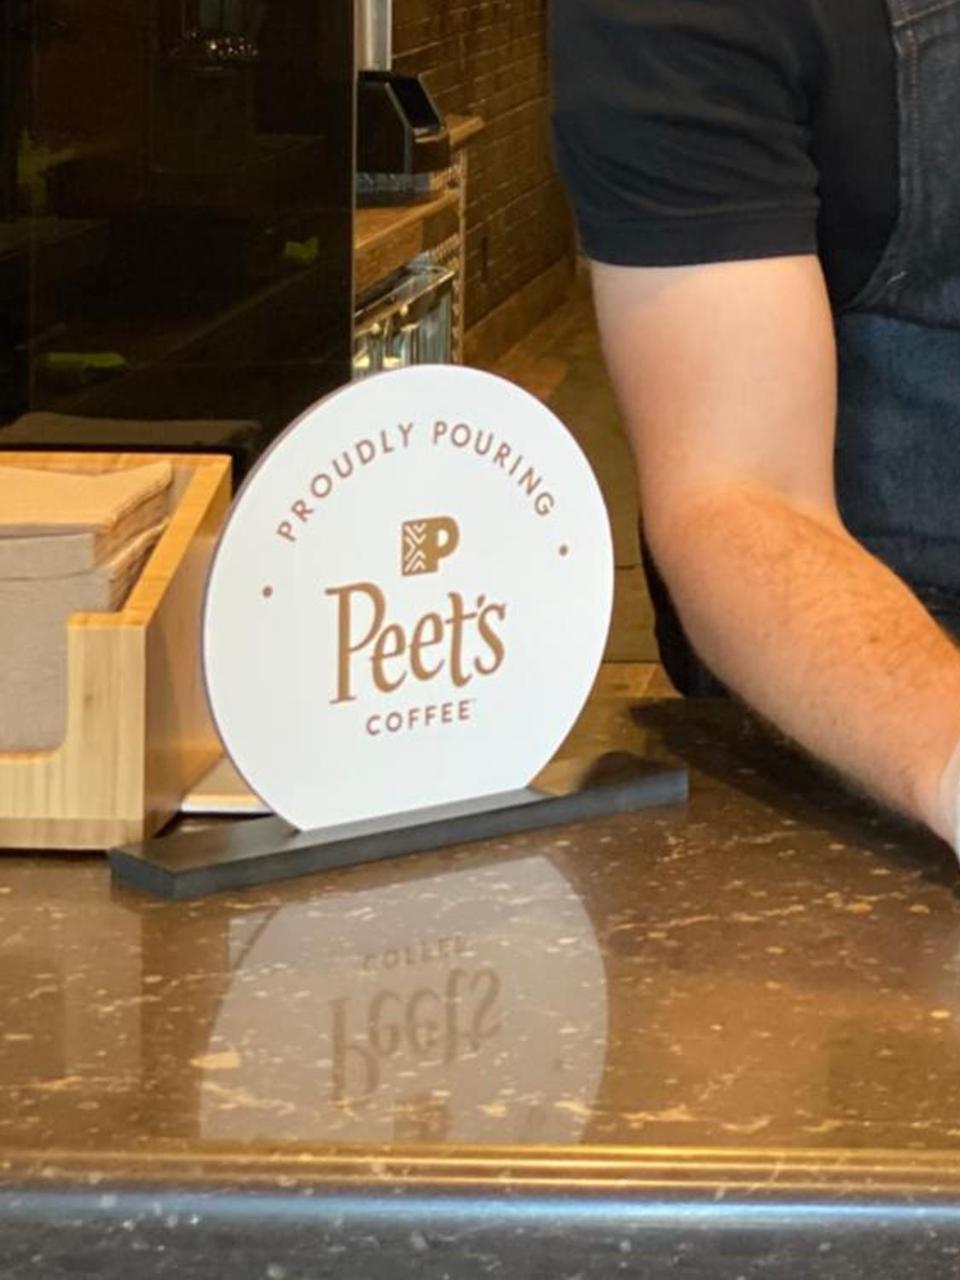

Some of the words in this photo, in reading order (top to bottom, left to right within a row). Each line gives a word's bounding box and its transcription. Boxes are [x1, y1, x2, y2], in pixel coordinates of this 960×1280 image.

[276, 422, 413, 542] PROUDLY
[433, 420, 555, 517] POURING
[324, 582, 507, 704] Peet's
[365, 699, 472, 736] COFFEE
